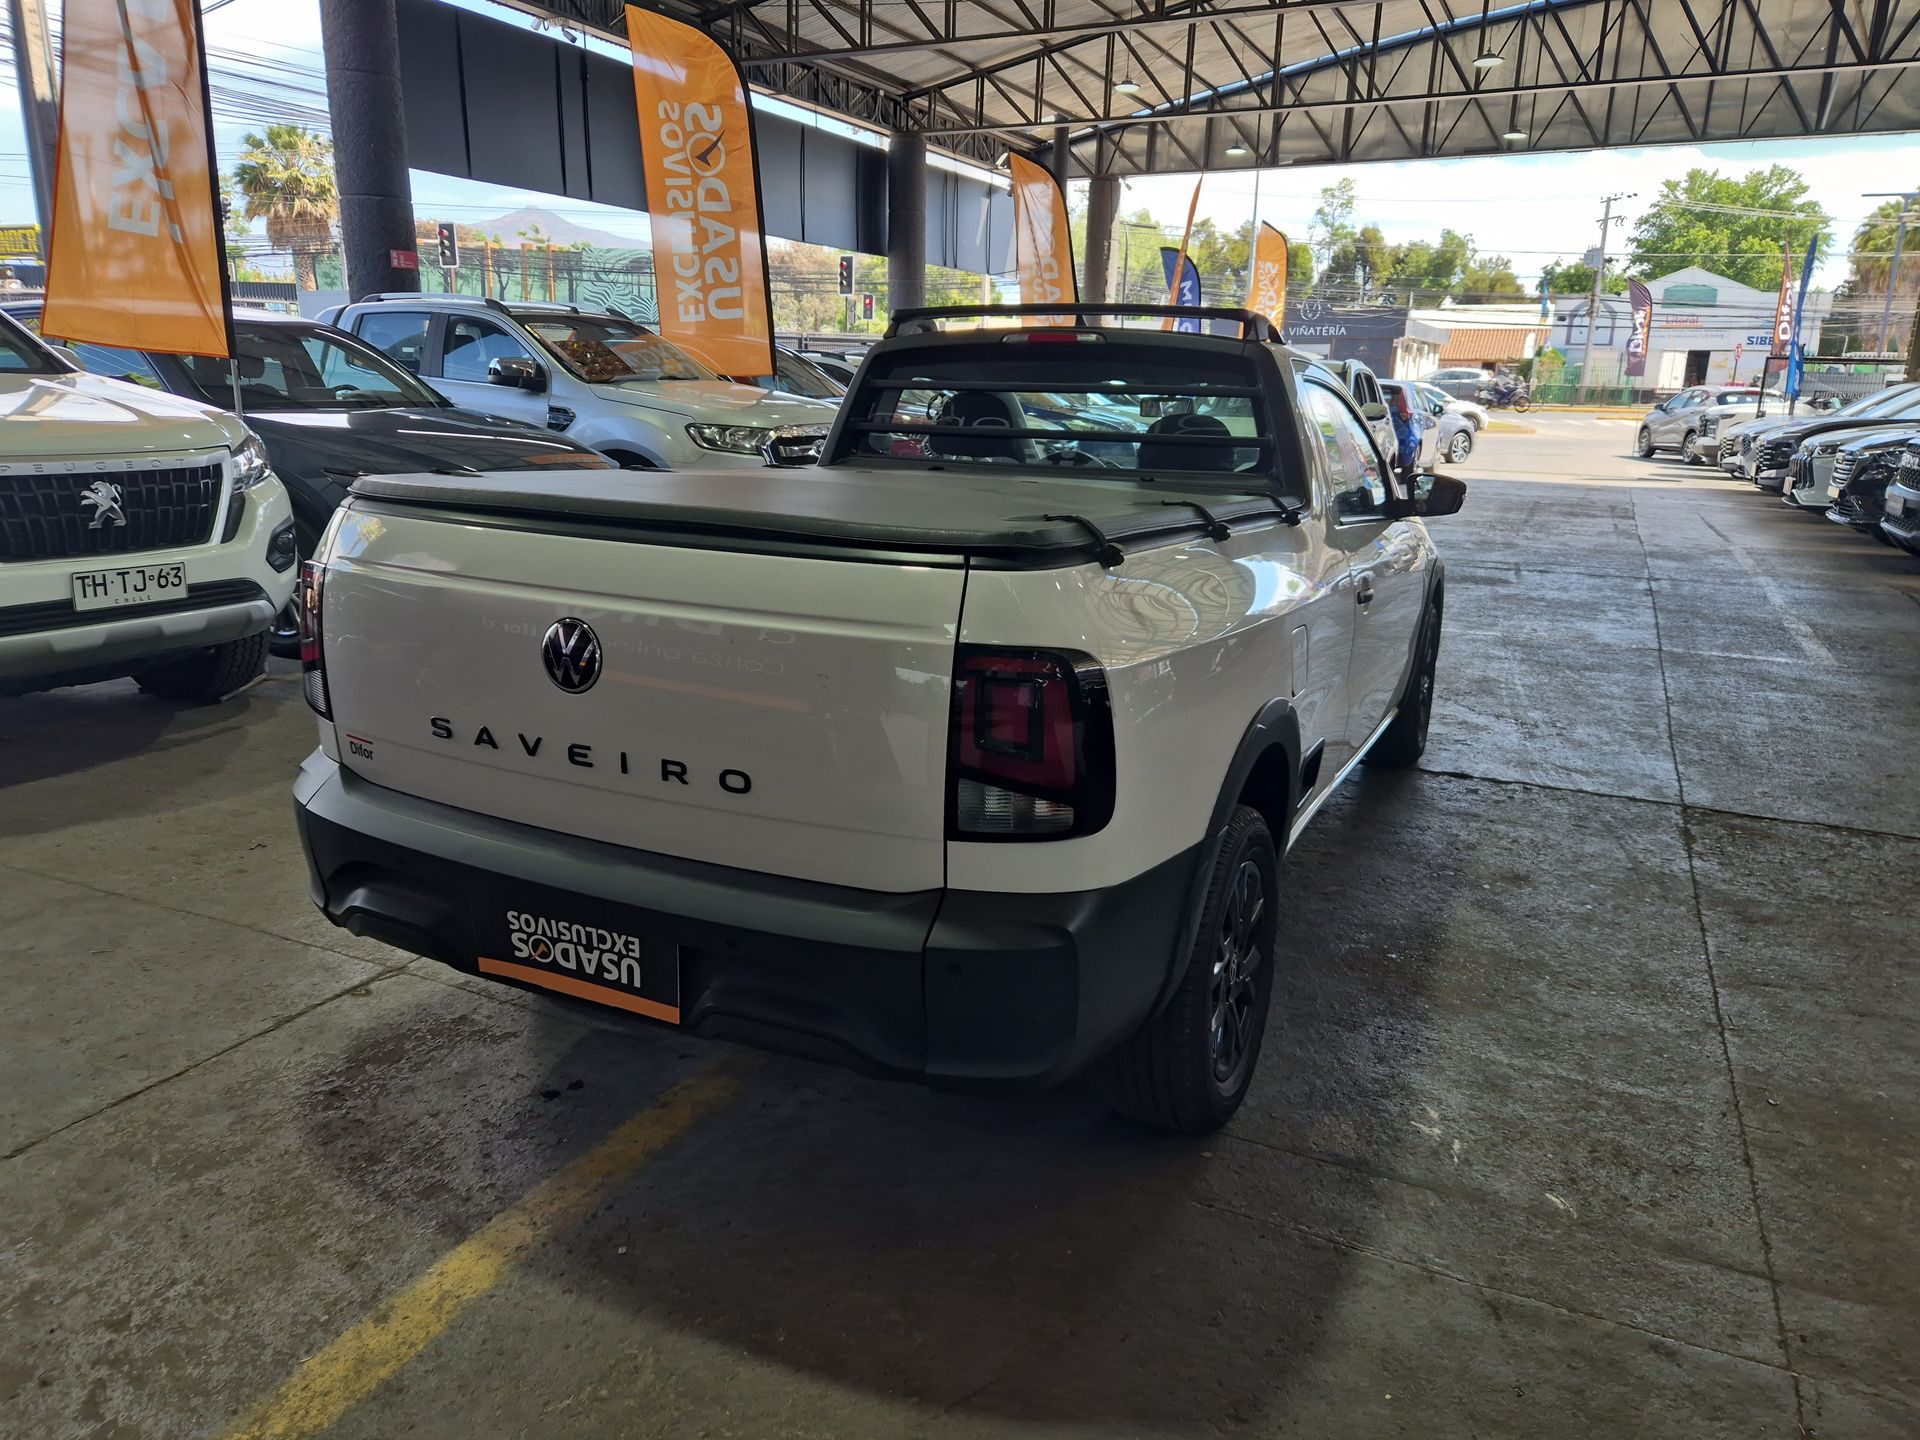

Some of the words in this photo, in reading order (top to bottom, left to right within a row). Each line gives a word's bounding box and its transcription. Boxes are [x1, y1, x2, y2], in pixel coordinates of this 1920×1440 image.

[1288, 325, 1347, 336] VIÑATERÍA
[1746, 335, 1774, 345] SIBE
[350, 740, 374, 760] Difor
[430, 716, 752, 795] SAVEIRO
[506, 910, 640, 958] EXCLUSIVOS
[511, 931, 641, 988] USADOS
